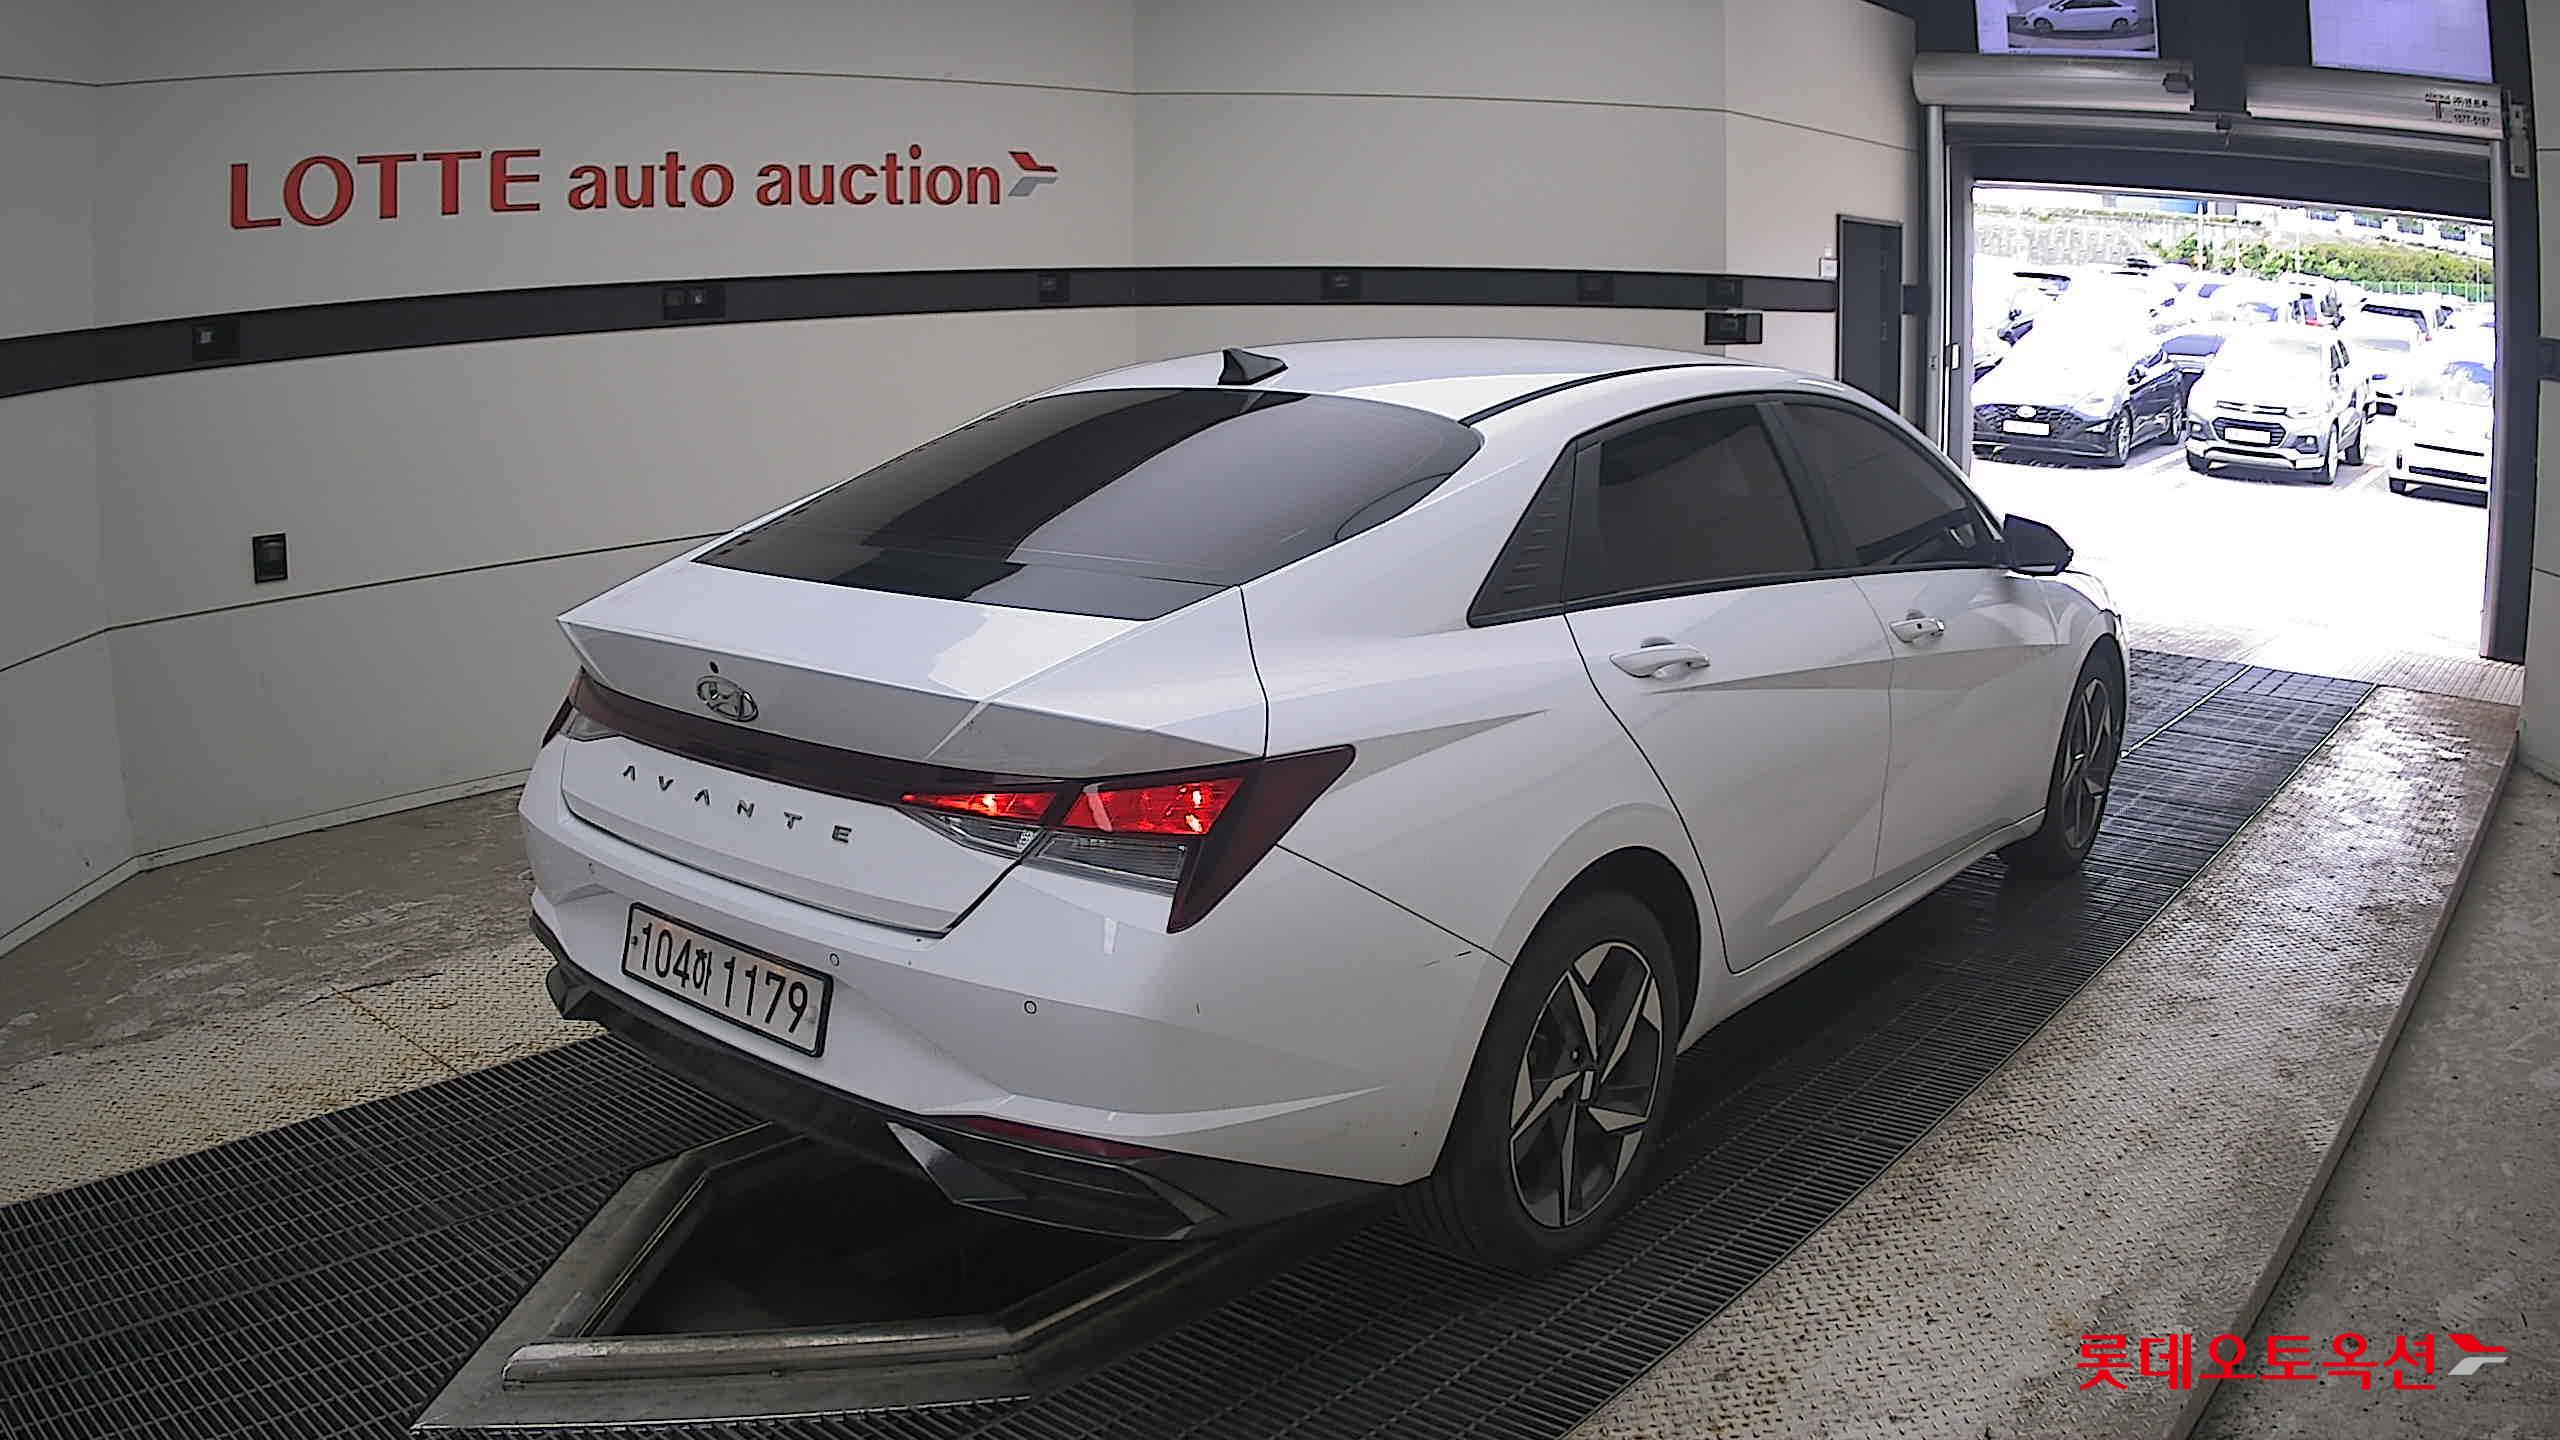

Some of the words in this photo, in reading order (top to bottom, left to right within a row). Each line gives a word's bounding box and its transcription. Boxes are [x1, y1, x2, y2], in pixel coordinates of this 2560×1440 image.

[230, 148, 541, 230] LOTTE
[567, 151, 735, 210] auto
[756, 143, 1001, 206] auction
[623, 765, 852, 844] AVANTE
[641, 922, 712, 996] 104하
[724, 956, 808, 1033] 1179
